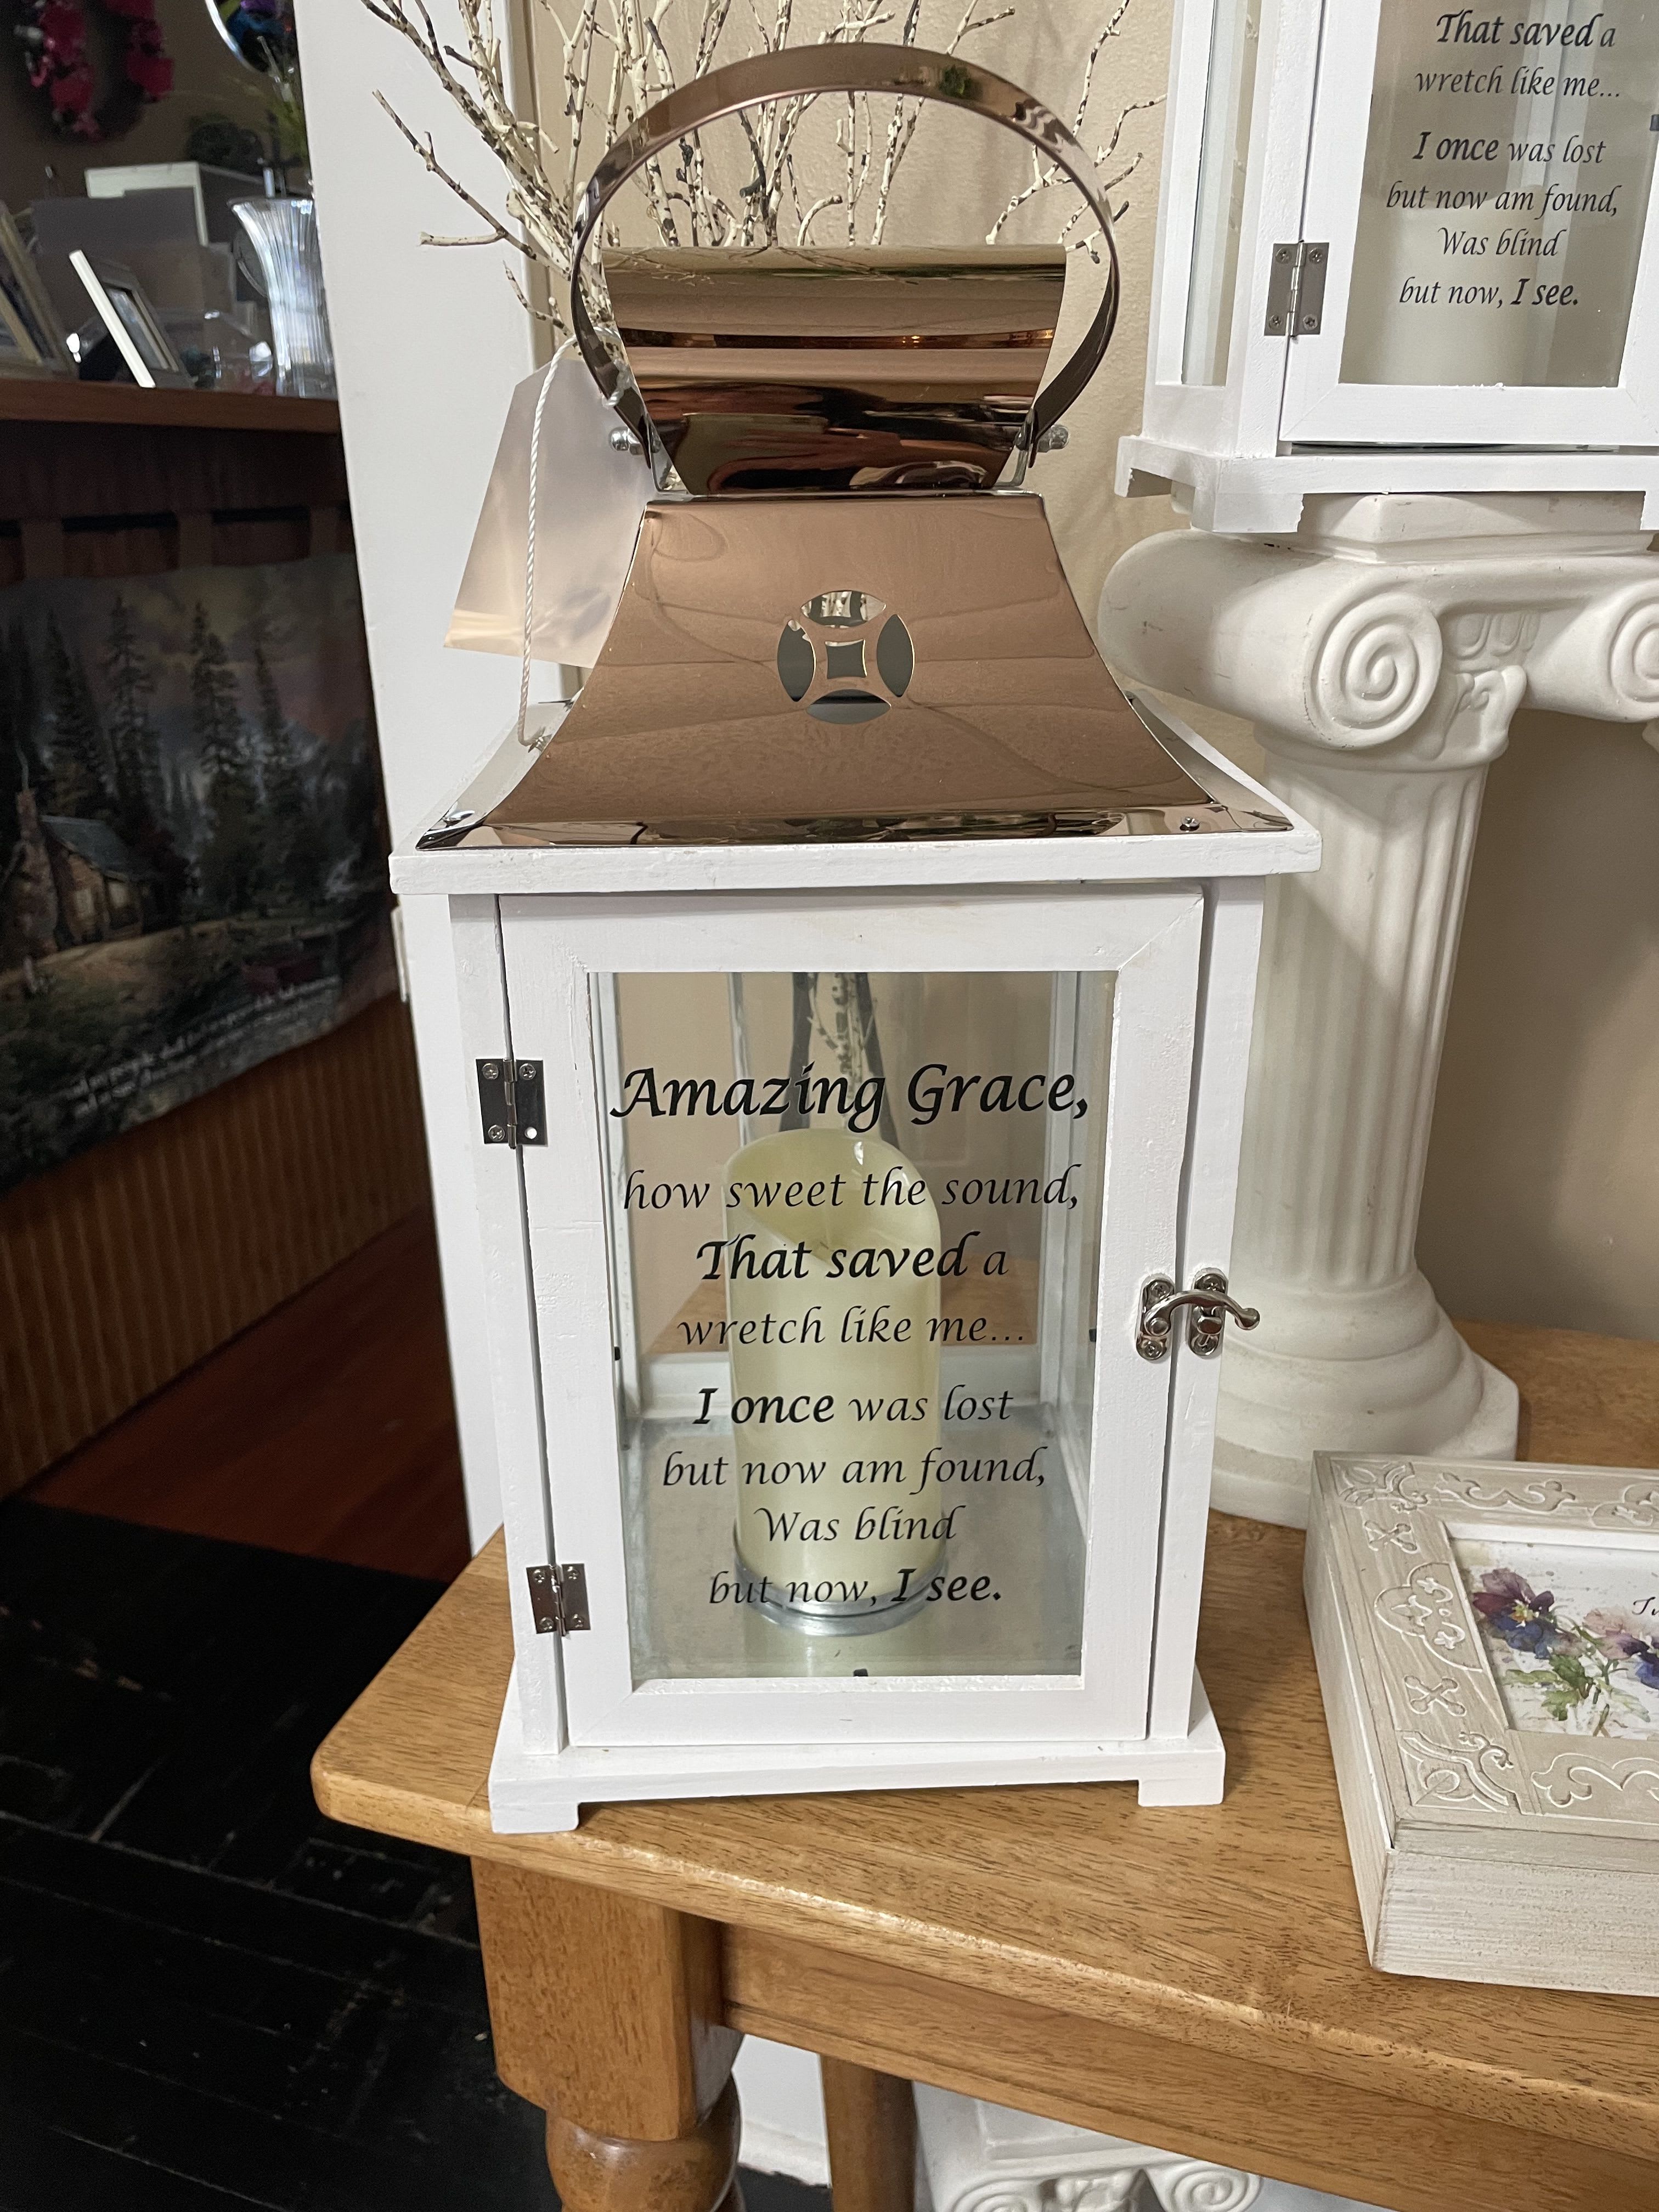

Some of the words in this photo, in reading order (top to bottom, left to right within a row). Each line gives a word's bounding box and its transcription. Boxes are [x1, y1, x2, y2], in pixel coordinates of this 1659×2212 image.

[1437, 10, 1504, 43] That
[1510, 14, 1604, 47] saved
[1601, 27, 1616, 47] a
[1415, 66, 1502, 94] wretch
[1510, 66, 1554, 95] like
[1563, 77, 1620, 98] me...
[1413, 131, 1431, 160] I
[1436, 137, 1498, 161] once
[1509, 142, 1555, 162] was
[1563, 135, 1606, 163] lost
[1386, 181, 1430, 208] but
[1436, 191, 1488, 209] now
[1496, 191, 1534, 210] am
[1534, 184, 1621, 219] found,
[1438, 227, 1488, 255] Was
[1496, 229, 1567, 256] blind
[1400, 277, 1441, 303] but
[1448, 285, 1503, 308] now,
[1510, 279, 1530, 304] I
[1532, 285, 1578, 306] see.
[610, 1060, 885, 1133] Amazing
[907, 1063, 1088, 1124] Grace,
[623, 1170, 712, 1210] how
[726, 1175, 845, 1207] sweet
[862, 1167, 926, 1206] the
[942, 1164, 1081, 1209] sound,
[697, 1234, 812, 1279] That
[825, 1231, 981, 1278] saved
[983, 1249, 1008, 1276] a
[677, 1307, 825, 1345] wretch
[840, 1306, 912, 1344] like
[927, 1318, 1024, 1342] me...
[692, 1388, 719, 1424] I
[731, 1395, 834, 1424] once
[849, 1392, 928, 1421] was
[944, 1385, 1014, 1421] lost
[663, 1451, 730, 1486] but
[741, 1462, 826, 1485] now
[842, 1462, 906, 1484] am
[910, 1446, 1047, 1495] found,
[754, 1508, 839, 1542] Was
[855, 1506, 966, 1541] blind
[709, 1572, 773, 1605] but
[785, 1581, 878, 1606] now,
[892, 1570, 917, 1603] I
[926, 1576, 1002, 1601] see.
